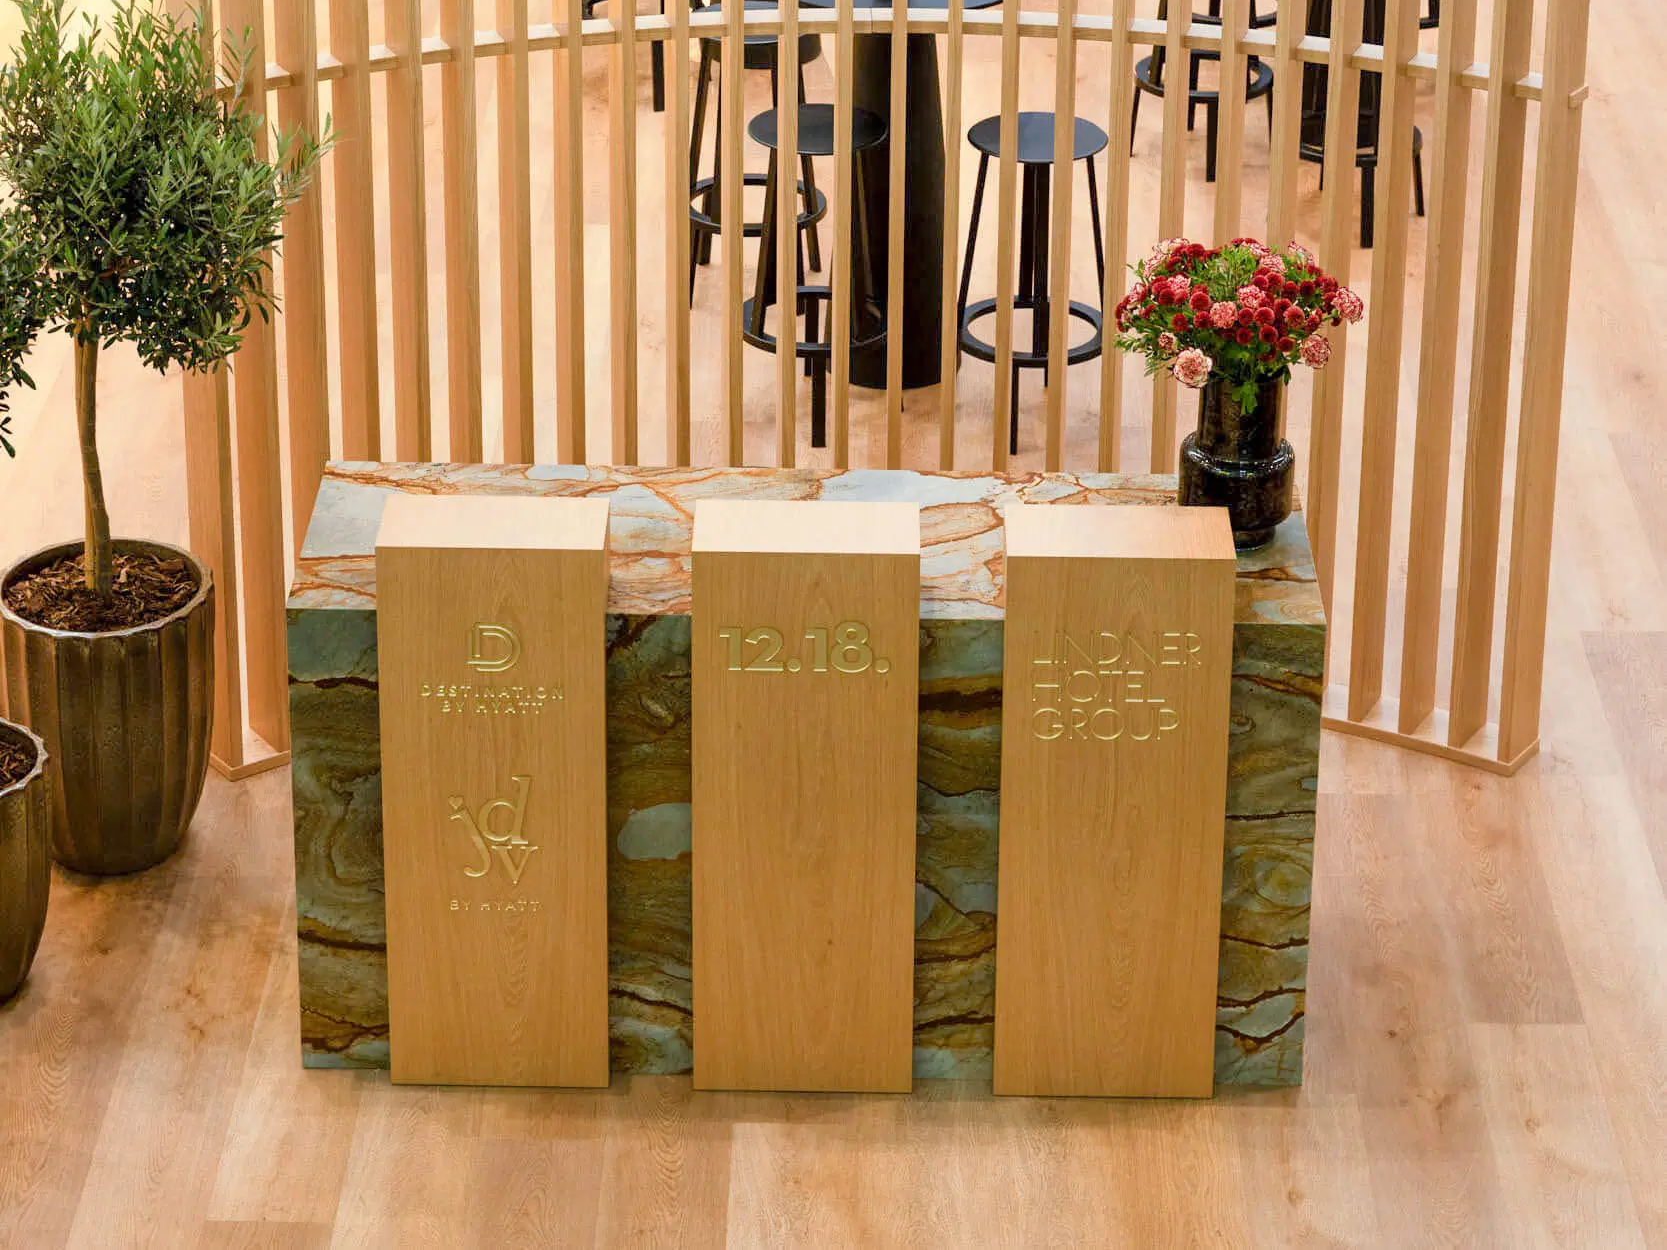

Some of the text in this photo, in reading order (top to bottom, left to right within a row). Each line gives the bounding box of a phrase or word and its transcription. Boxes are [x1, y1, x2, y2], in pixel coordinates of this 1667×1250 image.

[719, 620, 890, 673] 12.18.
[1032, 630, 1202, 666] LINDNER
[421, 683, 564, 699] DESTINATION
[1031, 670, 1166, 703] HOTEL
[441, 700, 544, 715] BY HYATT
[1032, 707, 1180, 741] GROUP
[450, 900, 541, 913] BY HYATT
